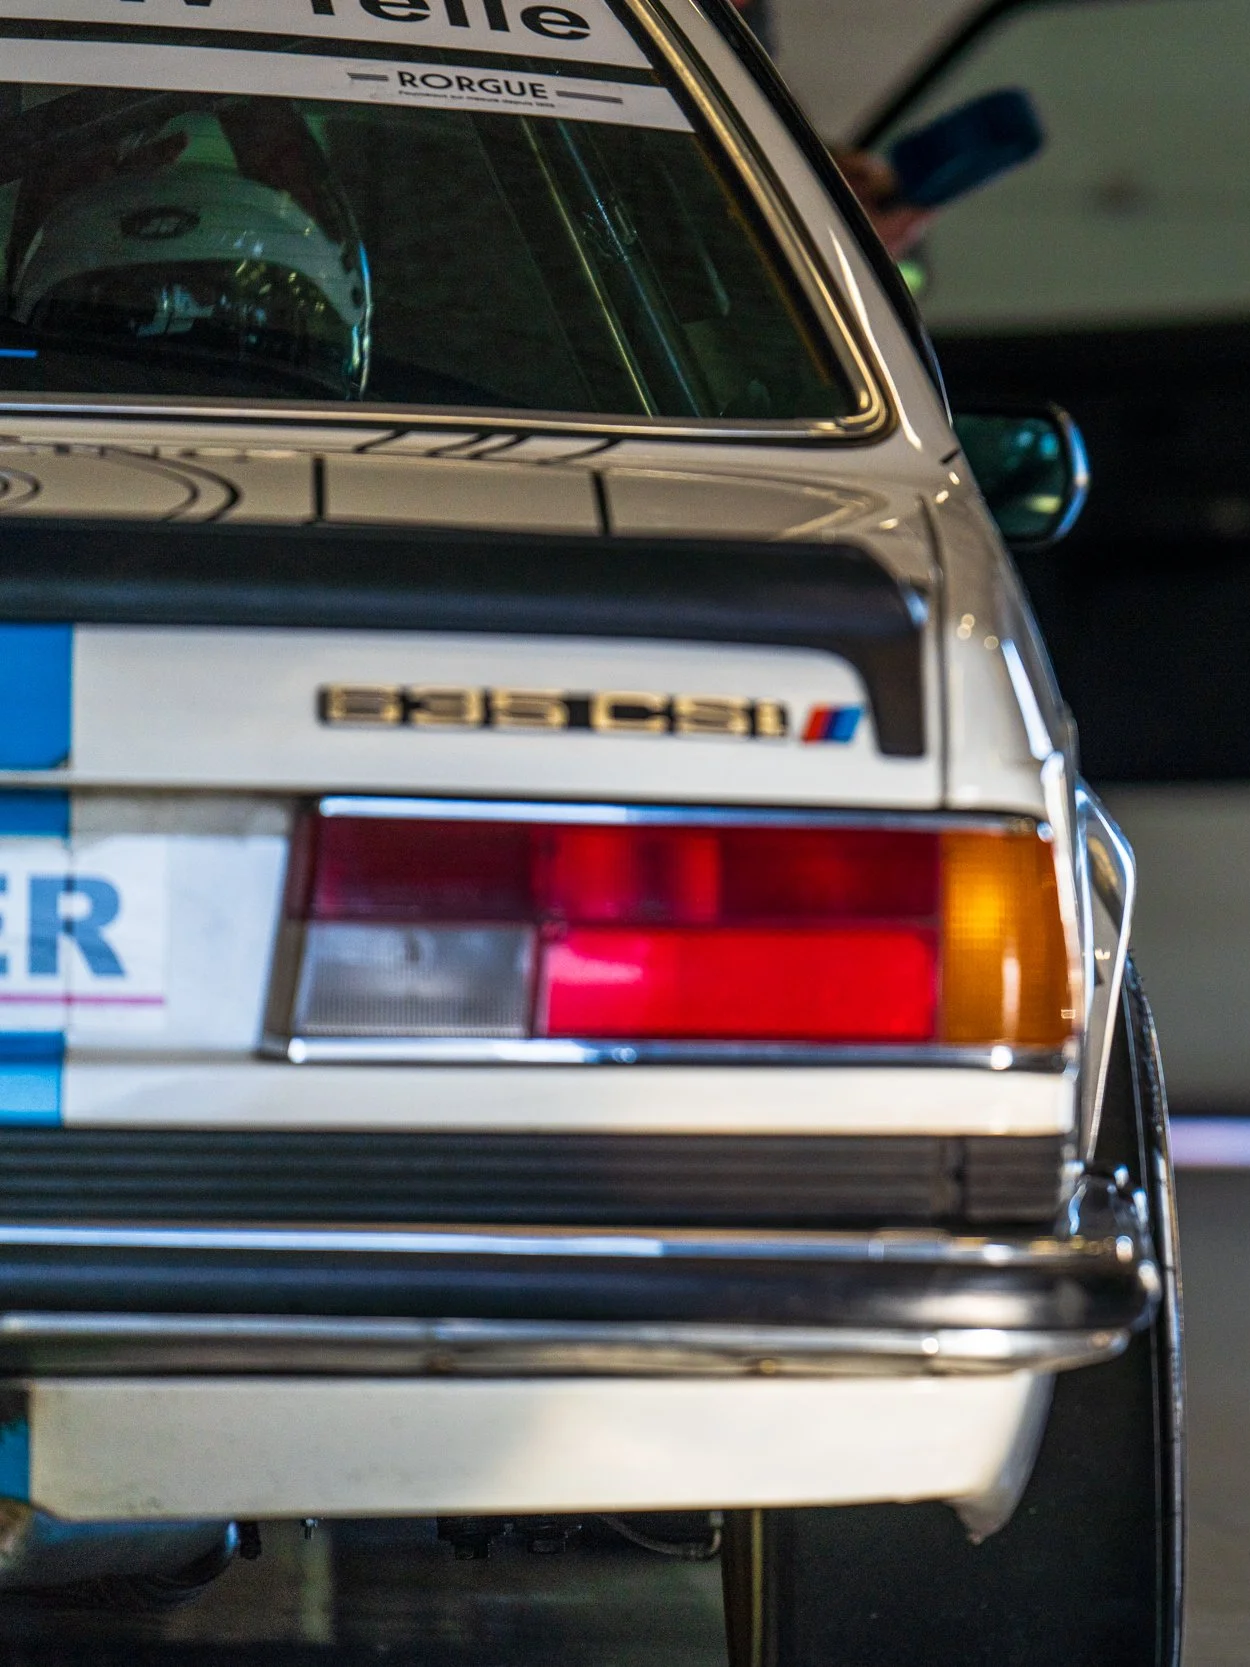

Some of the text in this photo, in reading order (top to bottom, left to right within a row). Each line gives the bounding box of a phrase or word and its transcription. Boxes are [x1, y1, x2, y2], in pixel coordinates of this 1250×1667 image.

[397, 71, 549, 99] RORGUE
[322, 684, 567, 731] 635
[0, 873, 126, 976] R
